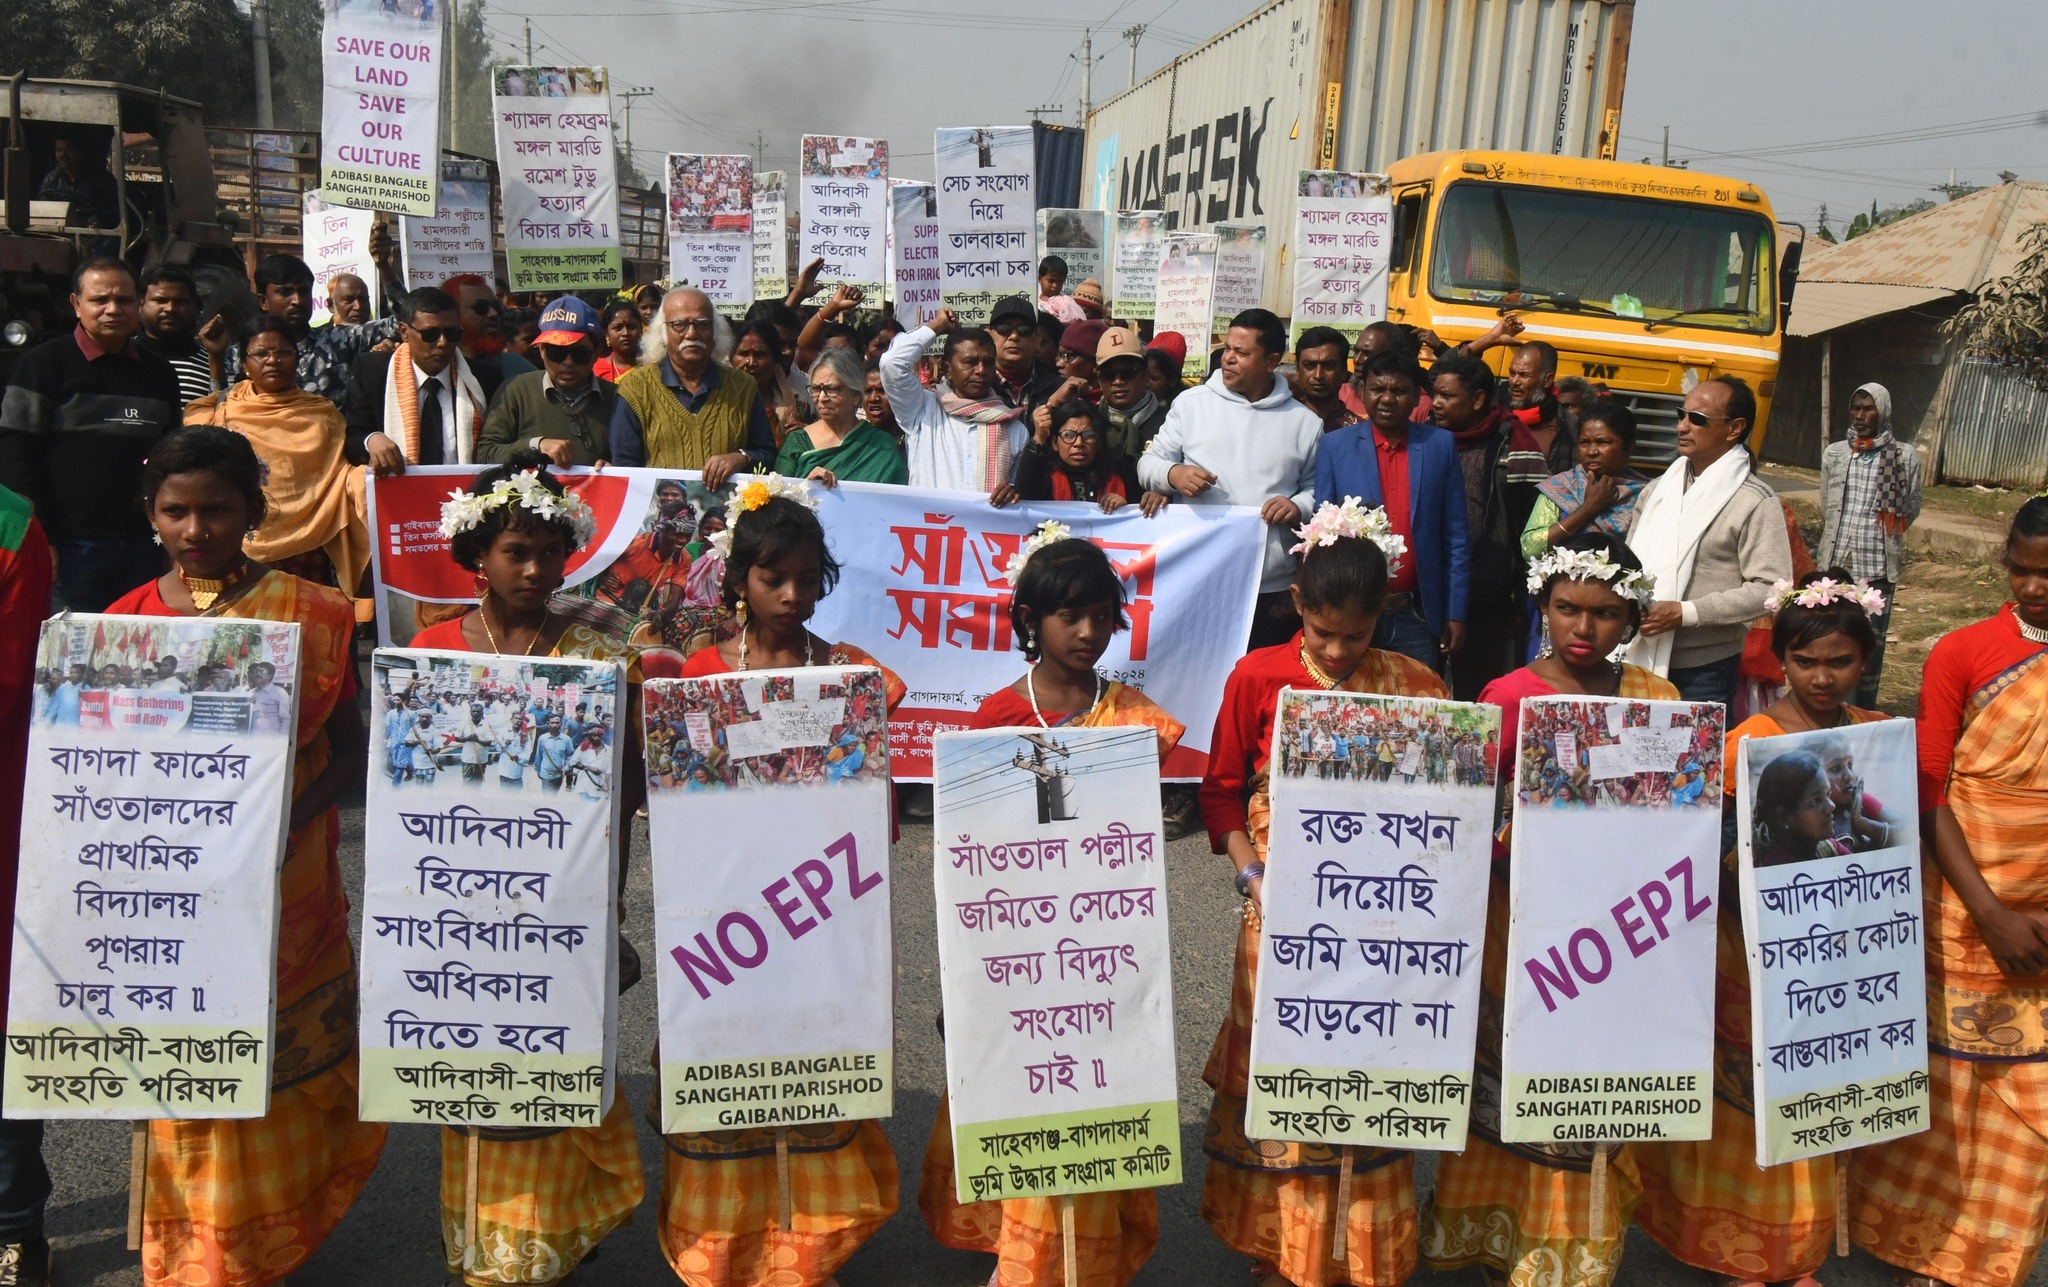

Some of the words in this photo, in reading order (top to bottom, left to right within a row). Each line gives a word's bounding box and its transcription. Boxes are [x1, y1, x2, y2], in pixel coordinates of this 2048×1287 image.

[337, 37, 384, 57] SAVE
[390, 43, 430, 62] OUR
[356, 66, 407, 86] LAND
[359, 94, 406, 114] SAVE
[503, 112, 552, 129] শ্যামল
[362, 122, 402, 140] OUR
[514, 141, 551, 156] মঙ্গল
[557, 136, 601, 156] মারডি
[339, 146, 420, 169] CULTURE
[1119, 100, 1274, 233] MAERSK
[331, 170, 371, 182] ADIBASI
[375, 175, 427, 189] BANGALEE
[524, 168, 567, 184] রমেশ
[943, 176, 971, 192] সেচ
[975, 174, 1029, 192] সংযোগ
[326, 182, 376, 195] SANGHATI
[380, 188, 430, 202] PARISHOD
[811, 182, 869, 198] আদিবাসী
[346, 196, 411, 213] GAIBANDHA.
[538, 196, 586, 212] হত্যার
[969, 199, 1004, 220] নিয়ে
[323, 216, 348, 234] তিন
[1301, 210, 1340, 224] শ্যামল
[422, 223, 470, 236] হামলাকারী
[518, 218, 560, 239] বিচার
[566, 218, 593, 238] চাই
[809, 220, 838, 236] ঐক্য
[844, 226, 870, 239] গড়ে
[319, 237, 354, 259] ফসলি
[687, 243, 704, 252] তিন
[811, 241, 866, 256] প্রতিরোধ
[949, 232, 1026, 249] তালবাহানা
[1308, 234, 1338, 246] মঙ্গল
[1343, 231, 1380, 247] মারডি
[439, 257, 459, 266] এবং
[699, 264, 729, 273] জমিতে
[945, 261, 1001, 277] চলবেনা
[1006, 261, 1030, 275] চক
[1313, 257, 1348, 270] রমেশ
[409, 269, 433, 280] নিহত
[562, 272, 589, 283] সংগ্রাম
[592, 268, 617, 281] কমিটি
[702, 280, 727, 288] EPZ
[896, 269, 915, 281] FOR
[904, 290, 919, 302] ON
[1322, 280, 1360, 293] হত্যার
[1303, 297, 1337, 315] বিচার
[1342, 299, 1364, 316] চাই
[541, 309, 576, 325] RUSSIA
[1110, 335, 1122, 346] L
[1582, 362, 1619, 379] TAT
[125, 408, 138, 418] UR
[1114, 669, 1144, 681] ২০২৪
[112, 696, 134, 707] Mass
[137, 697, 184, 711] Gathering
[124, 713, 141, 724] and
[143, 714, 168, 727] Rally
[916, 720, 932, 736] ভূমি
[49, 747, 141, 776] বাগদা
[151, 744, 251, 780] ফার্মের
[52, 786, 238, 826] সাঁওতালদের
[399, 805, 572, 849] আদিবাসী
[1299, 810, 1367, 844] রক্ত
[1376, 811, 1460, 851] যখন
[79, 835, 202, 871] প্রাথমিক
[949, 834, 1069, 876] সাঁওতাল
[1081, 822, 1155, 869] পল্লীর
[415, 856, 551, 902] হিসেবে
[73, 881, 201, 918] বিদ্যালয়
[1313, 861, 1438, 918] দিয়েছি
[1760, 864, 1912, 915] আদিবাসীদের
[669, 912, 769, 1001] NO
[761, 831, 883, 941] EPZ
[955, 888, 1058, 932] জমিতে
[1070, 888, 1156, 923] সেচের
[373, 909, 588, 953] সাংবিধানিক
[1523, 926, 1612, 1014] NO
[1610, 855, 1712, 959] EPZ
[1759, 924, 1849, 969] চাকরির
[1855, 911, 1919, 954] কোটা
[1270, 924, 1347, 971] জমি
[1358, 937, 1469, 977] আমরা
[982, 953, 1046, 986] জন্য
[1055, 938, 1139, 985] বিদ্যুৎ
[403, 961, 553, 1003] অধিকার
[55, 982, 114, 1018] চালু
[124, 985, 177, 1011] কর
[1785, 980, 1848, 1019] দিতে
[1855, 972, 1900, 1005] হবে
[1010, 998, 1115, 1040] সংযোগ
[1274, 996, 1402, 1040] ছাড়বো
[1412, 1001, 1455, 1039] না
[384, 1010, 483, 1049] দিতে
[494, 1025, 570, 1054] হবে
[5, 1026, 263, 1064] আদিবাসী-বাঙালি
[1769, 1028, 1871, 1073] বাস্তবায়ন
[1878, 1019, 1916, 1049] কর
[685, 1063, 764, 1081] ADIBASI
[772, 1055, 875, 1076] BANGALEE
[1024, 1052, 1078, 1094] চাই
[25, 1067, 128, 1104] সংহতি
[140, 1068, 242, 1103] পরিষদ
[676, 1085, 776, 1105] SANGHATI
[783, 1078, 882, 1098] PARISHOD
[1254, 1069, 1469, 1105] আদিবাসী-বাঙালি
[1526, 1078, 1598, 1093] ADIBASI
[1604, 1076, 1695, 1092] BANGALEE
[412, 1096, 497, 1123] সংহতি
[509, 1097, 600, 1125] পরিষদ
[718, 1103, 847, 1126] GAIBANDHA.
[1517, 1101, 1606, 1117] SANGHATI
[1612, 1099, 1701, 1115] PARISHOD
[1268, 1105, 1355, 1137] সংহতি
[1365, 1109, 1451, 1139] পরিষদ
[1554, 1123, 1666, 1139] GAIBANDHA.
[1790, 1117, 1853, 1148] সংহতি
[1860, 1103, 1919, 1135] পরিষদ
[1009, 1162, 1057, 1191] উদ্ধার
[1062, 1157, 1116, 1186] সংগ্রাম
[1120, 1144, 1172, 1178] কমিটি
